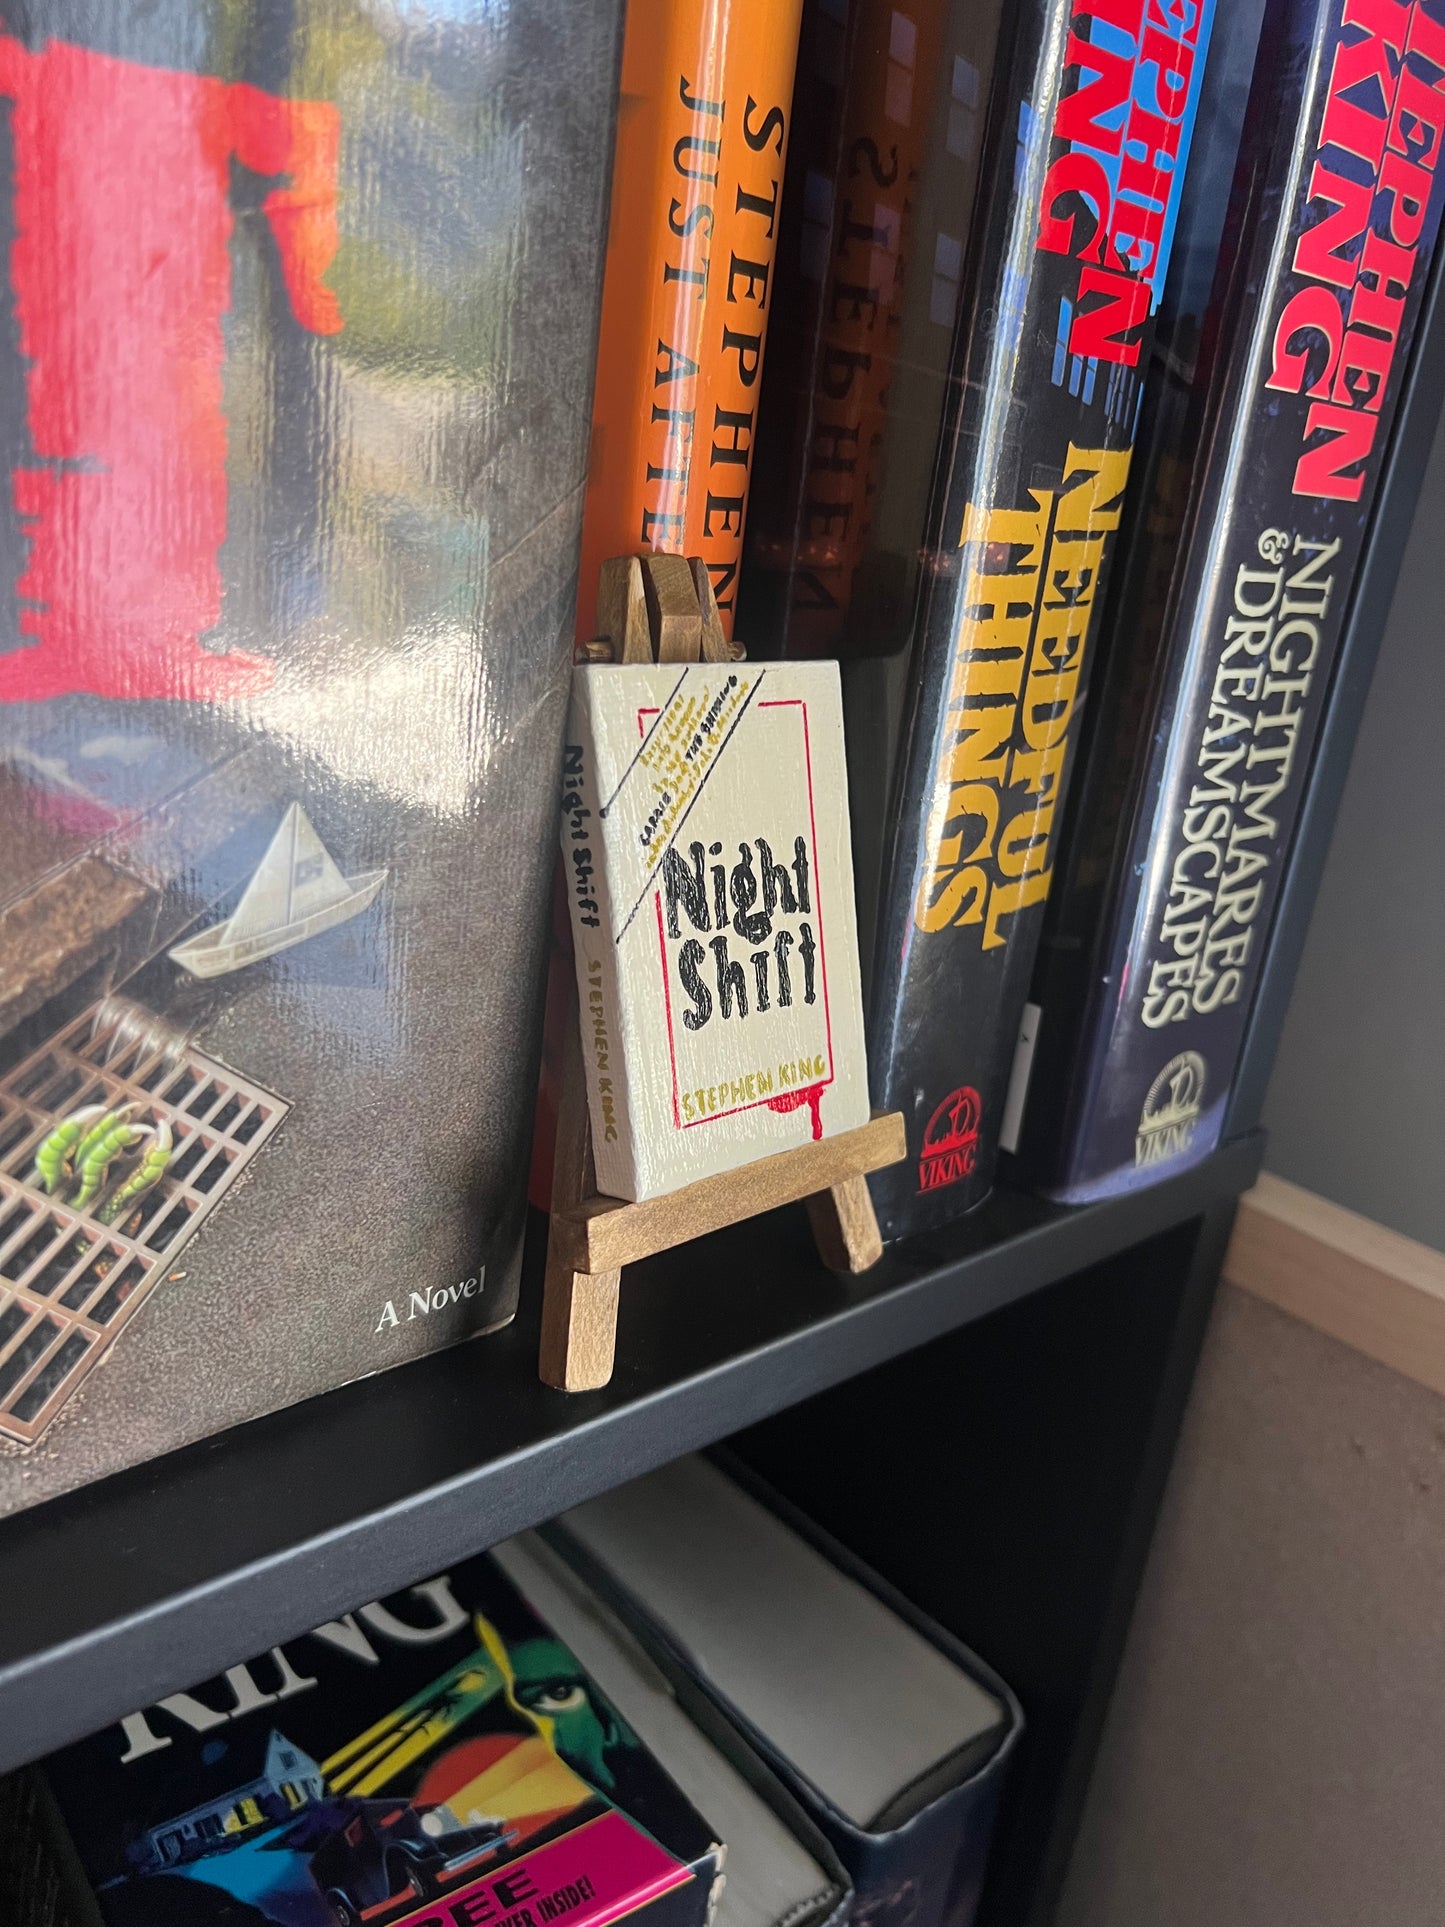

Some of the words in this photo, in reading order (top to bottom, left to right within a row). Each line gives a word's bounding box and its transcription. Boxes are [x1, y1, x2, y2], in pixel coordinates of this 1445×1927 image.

[663, 76, 727, 301] JUST
[703, 94, 785, 610] STEPHEN
[1258, 527, 1290, 567] &
[915, 489, 1055, 934] THINGS
[982, 441, 1134, 951] NEEDFUL
[561, 745, 591, 840] Night
[1141, 562, 1283, 1029] DREAMSCAPES
[1192, 535, 1342, 1014] NIGHTMARES
[573, 847, 600, 929] Shift
[662, 836, 811, 945] Night
[588, 959, 609, 1071] STEPHEN
[678, 922, 816, 1031] Shift
[682, 1067, 773, 1121] STEPHEN
[778, 1054, 826, 1088] KING
[1135, 1116, 1194, 1168] VIKING
[918, 1143, 977, 1190] VIKING
[374, 1300, 400, 1333] A
[408, 1264, 486, 1321] Novel
